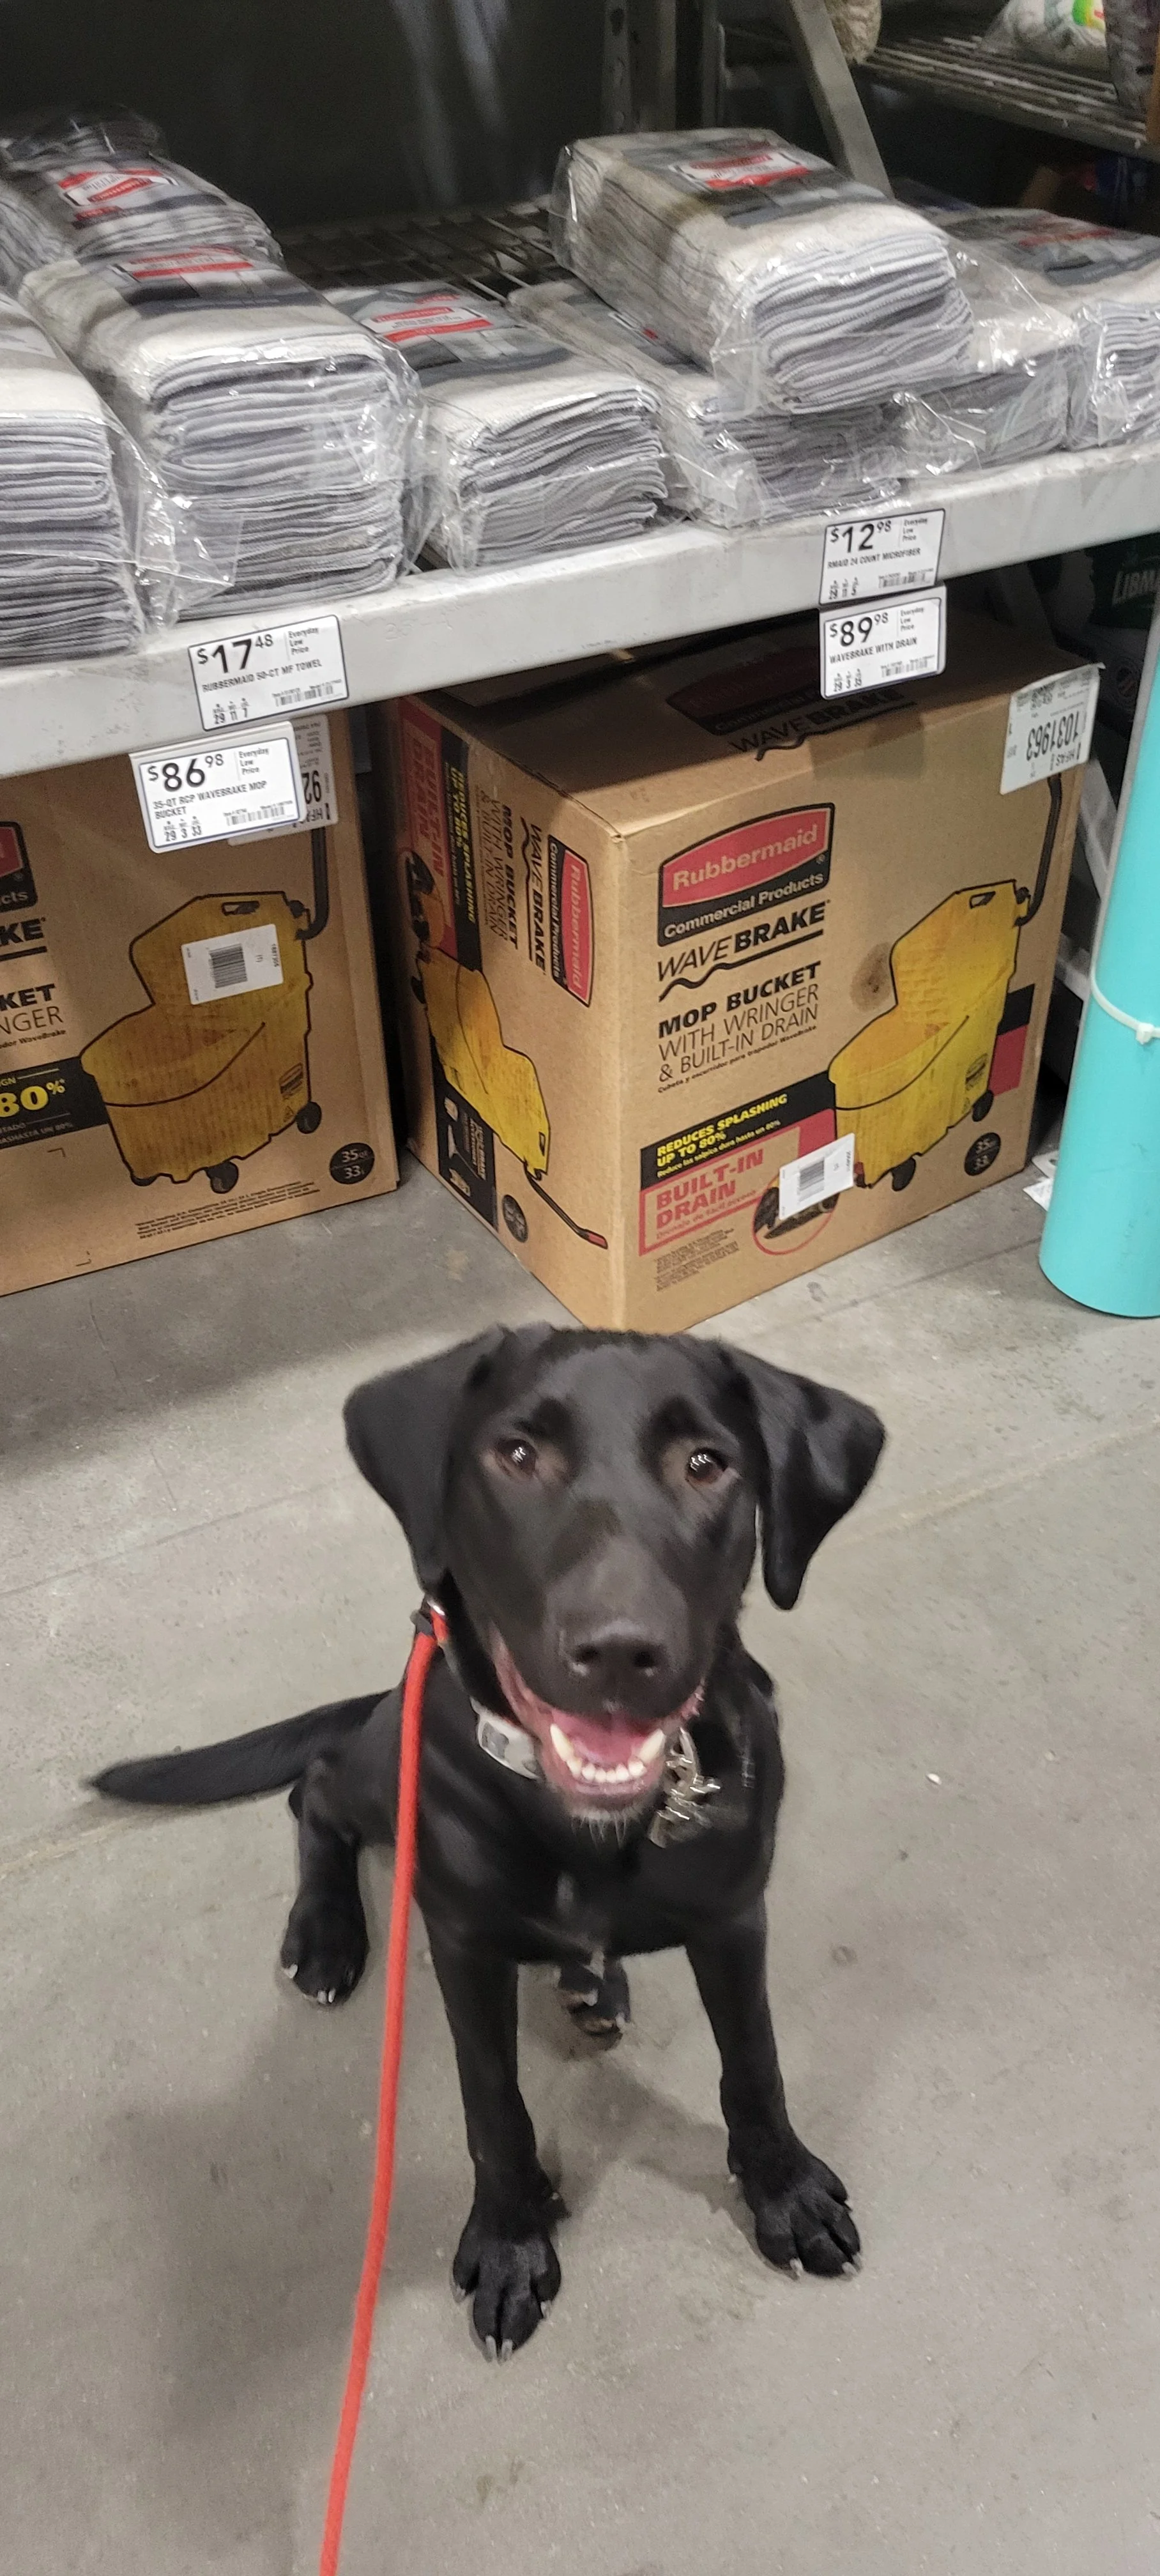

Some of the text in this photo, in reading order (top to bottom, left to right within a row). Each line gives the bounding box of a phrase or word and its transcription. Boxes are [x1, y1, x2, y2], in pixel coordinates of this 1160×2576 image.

[860, 553, 881, 564] COUNT
[881, 548, 921, 560] MICROFIBER
[900, 607, 925, 617] Everyday
[289, 627, 319, 640] Everyday
[289, 639, 304, 647] Low
[291, 647, 309, 656] Price
[829, 637, 918, 664] WAVEBRAKE WITH DRAIN
[202, 673, 255, 692] RUBBERMAID
[296, 659, 323, 671] TOWEL
[238, 747, 270, 759] Everyday
[242, 767, 260, 776] Price
[197, 784, 248, 801] WAVEBRAKE
[249, 781, 267, 791] MOP
[155, 806, 187, 820] BUCKET
[673, 824, 818, 891] Rubbermaid
[505, 865, 518, 950] BUCKET
[664, 872, 824, 939] Commercial Products
[0, 917, 44, 947] KE
[659, 960, 821, 1039] MOP BUCKET
[659, 983, 818, 1061] WITH WRINGER
[659, 1003, 818, 1082] & BUILT-IN DRAIN
[657, 1093, 788, 1157] REDUCES SPLASHING
[657, 1130, 727, 1167] UP TO 80%
[657, 1149, 764, 1210] BUILT-IN
[657, 1181, 736, 1229] DRAIN
